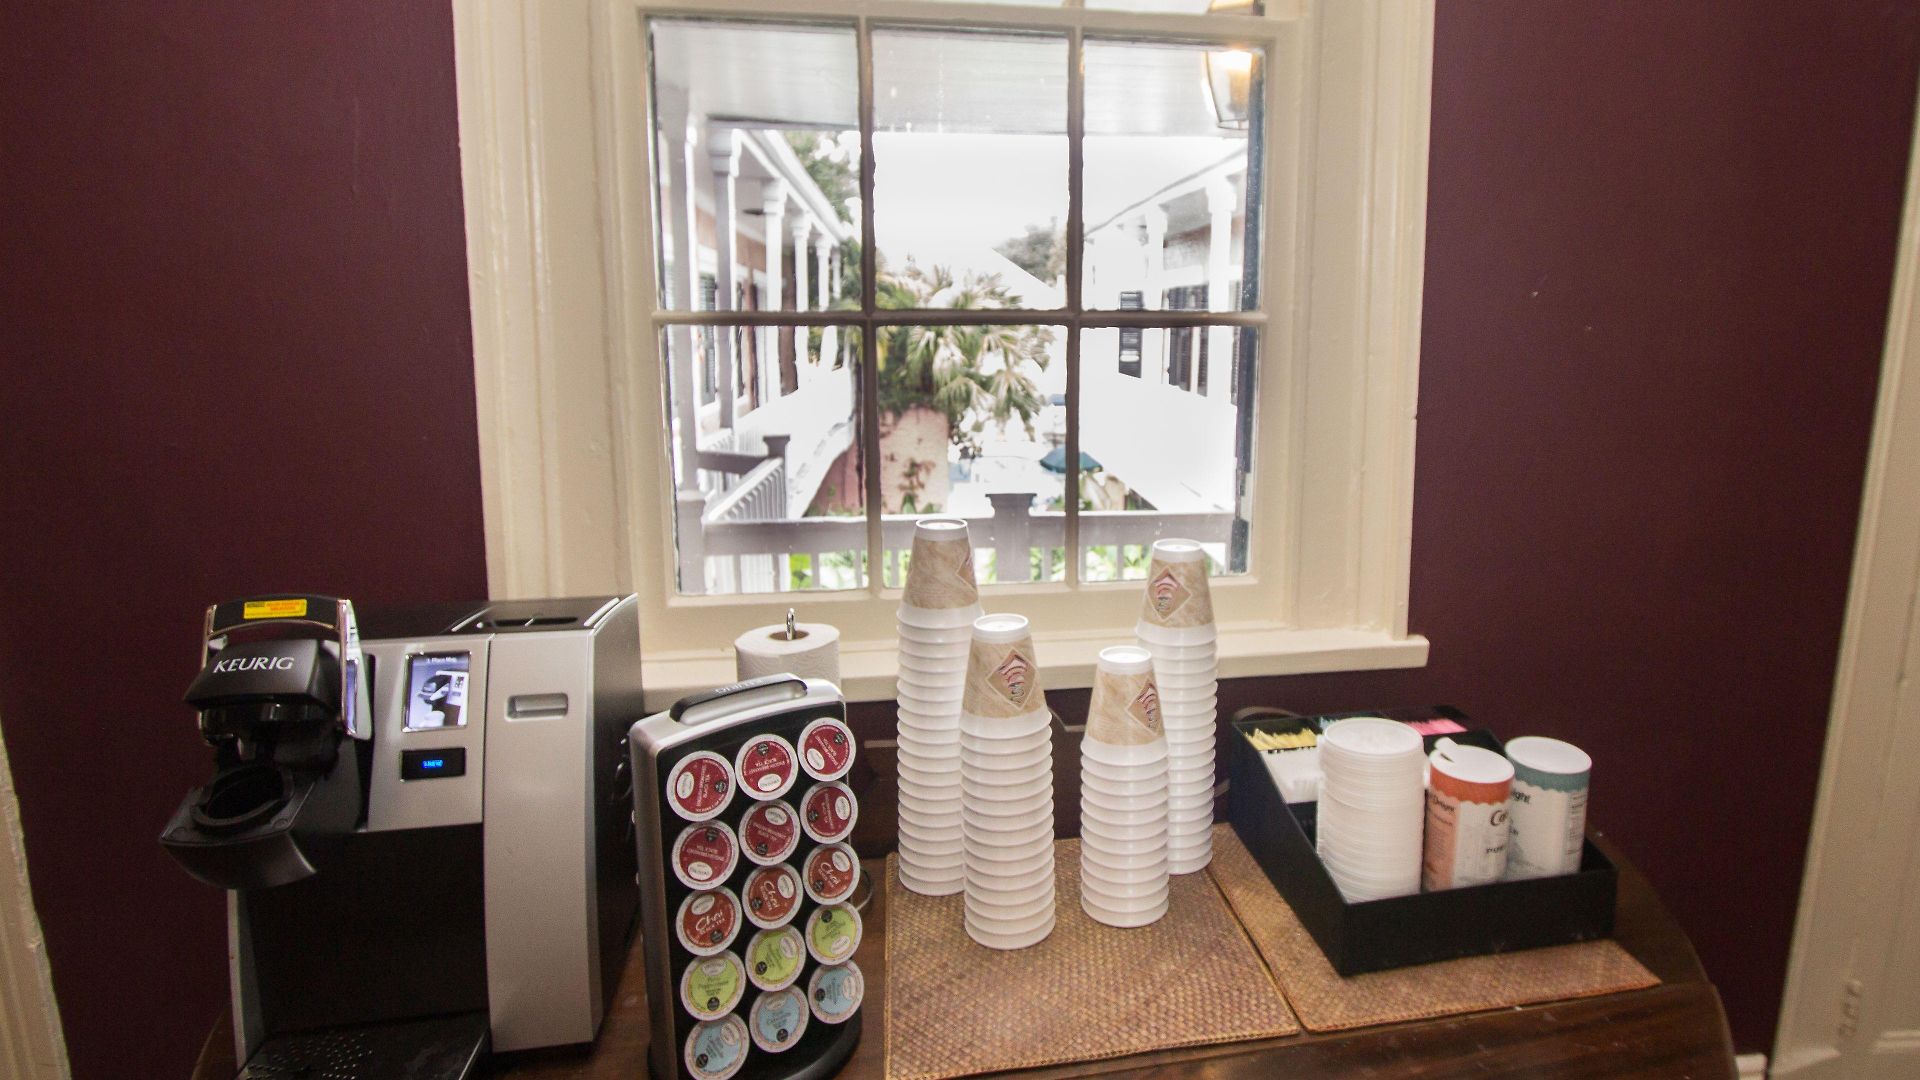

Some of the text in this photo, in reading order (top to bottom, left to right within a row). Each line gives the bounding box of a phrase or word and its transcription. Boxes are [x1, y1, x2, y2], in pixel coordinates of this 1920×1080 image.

[213, 656, 295, 673] KEURIG
[821, 862, 839, 885] Chai
[764, 882, 780, 908] Chai
[696, 911, 723, 930] Chai
